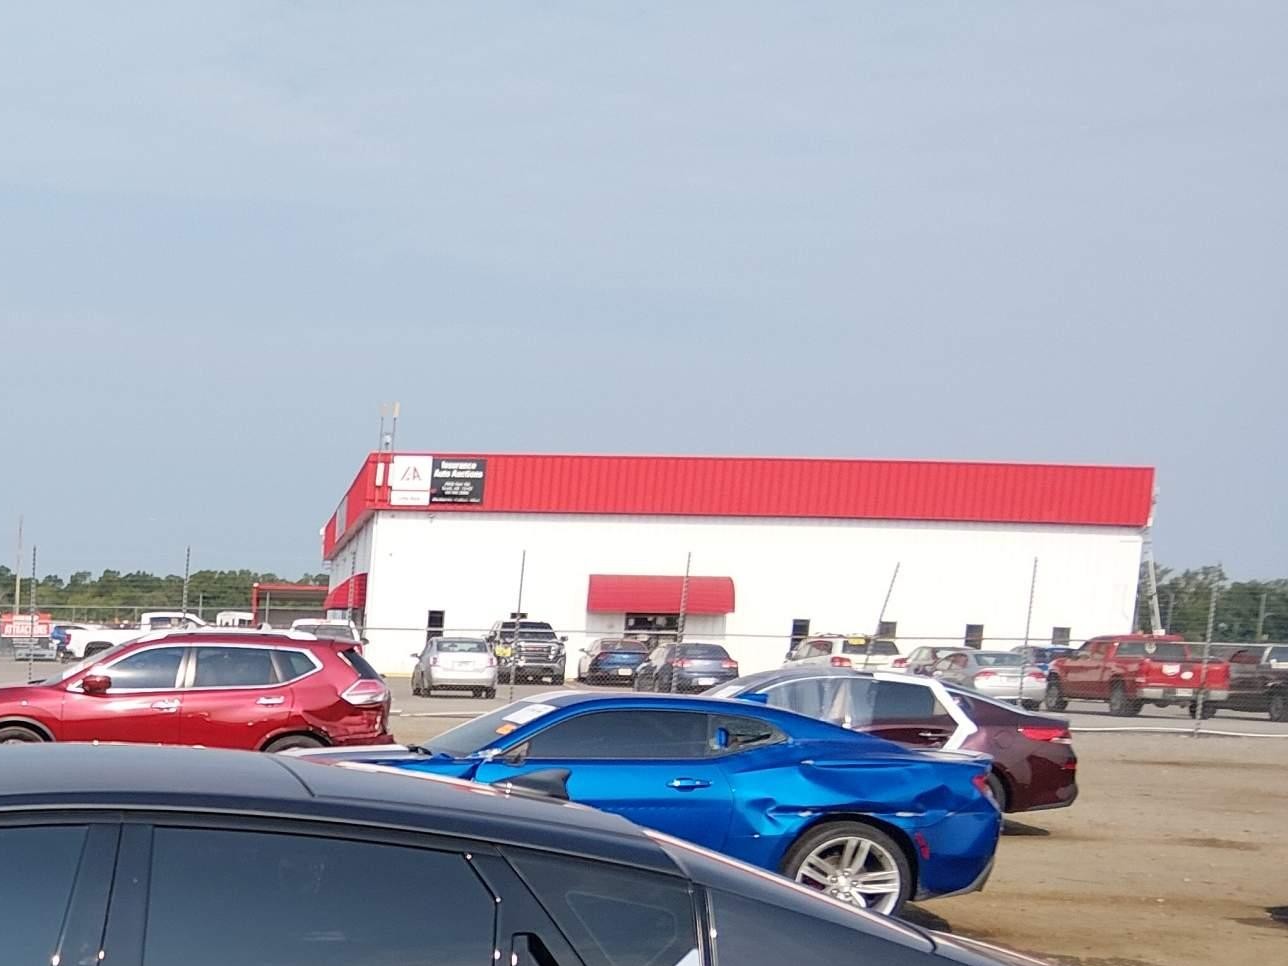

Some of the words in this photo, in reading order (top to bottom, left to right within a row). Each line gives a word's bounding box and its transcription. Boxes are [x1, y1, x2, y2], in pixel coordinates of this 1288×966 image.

[441, 461, 477, 470] Insurance
[433, 468, 451, 478] Auto
[451, 469, 484, 479] Auctions
